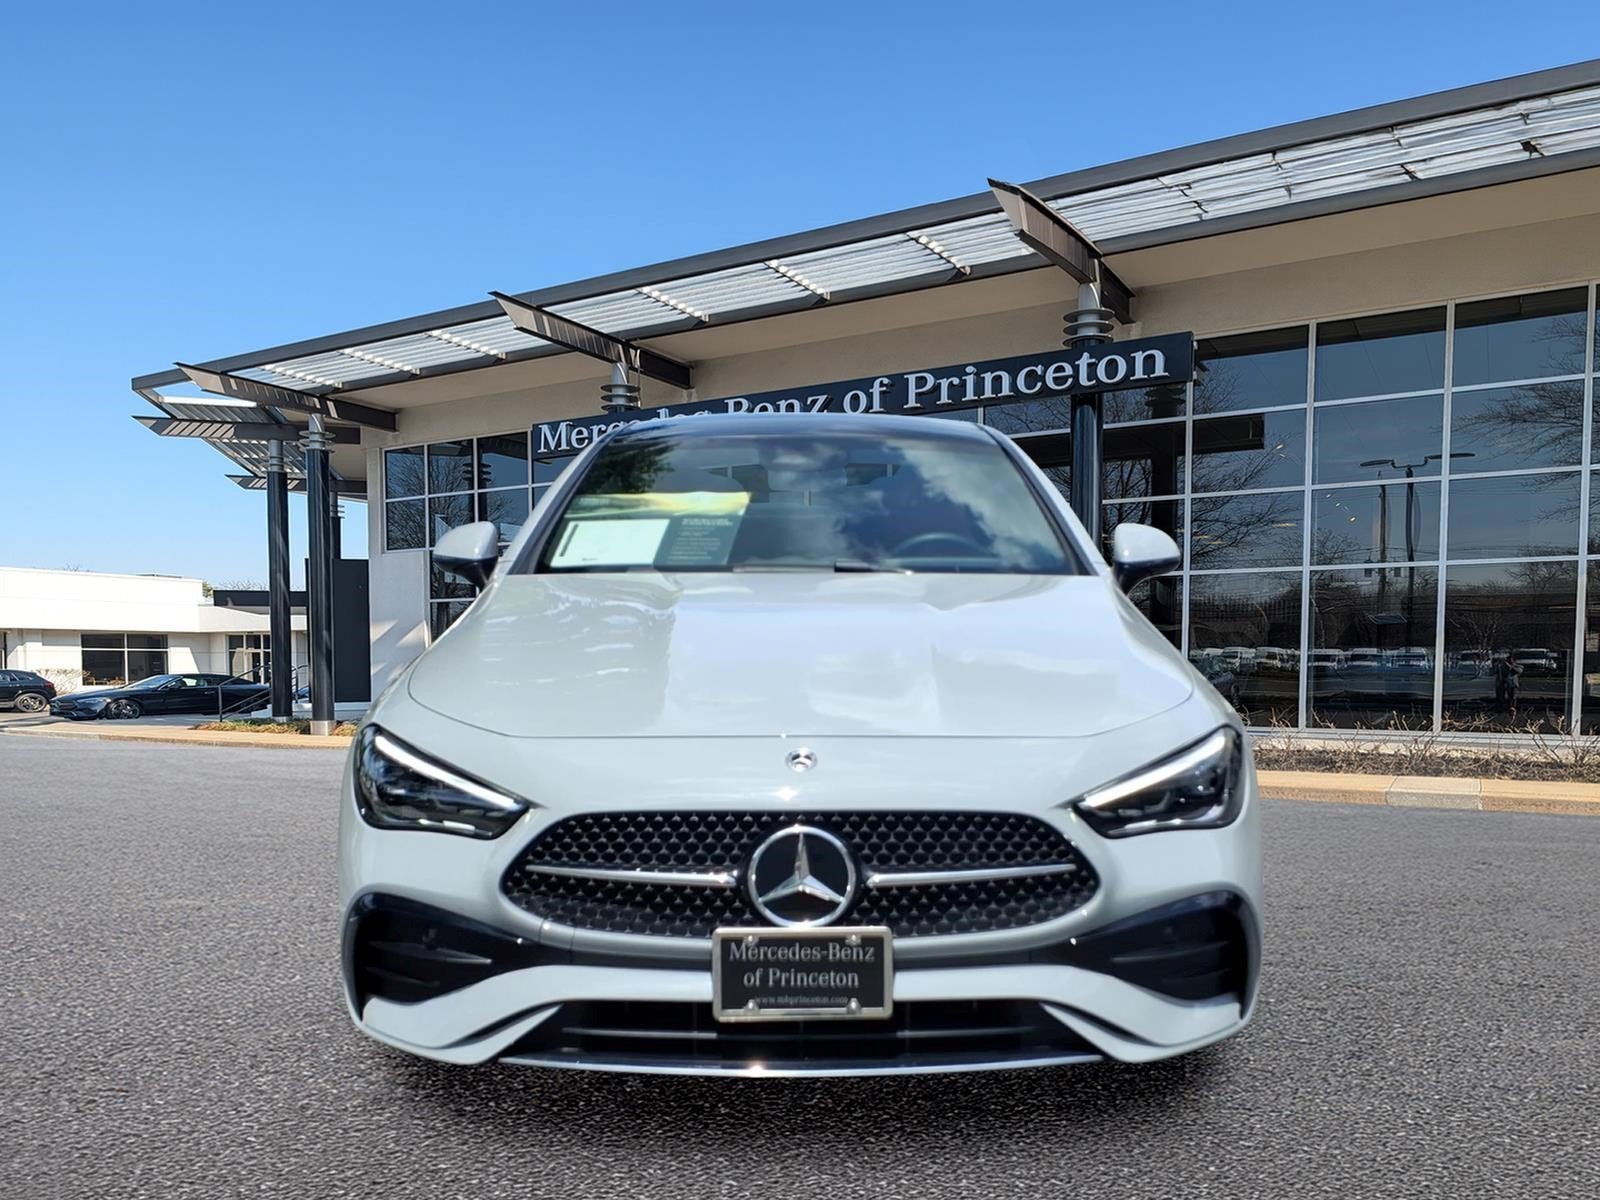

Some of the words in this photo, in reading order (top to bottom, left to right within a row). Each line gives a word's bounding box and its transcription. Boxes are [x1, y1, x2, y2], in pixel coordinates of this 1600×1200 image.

[843, 377, 888, 414] of
[903, 348, 1169, 408] Princeton
[729, 942, 875, 963] Mercedes-Benz
[743, 968, 764, 988] of
[768, 968, 860, 988] Princeton
